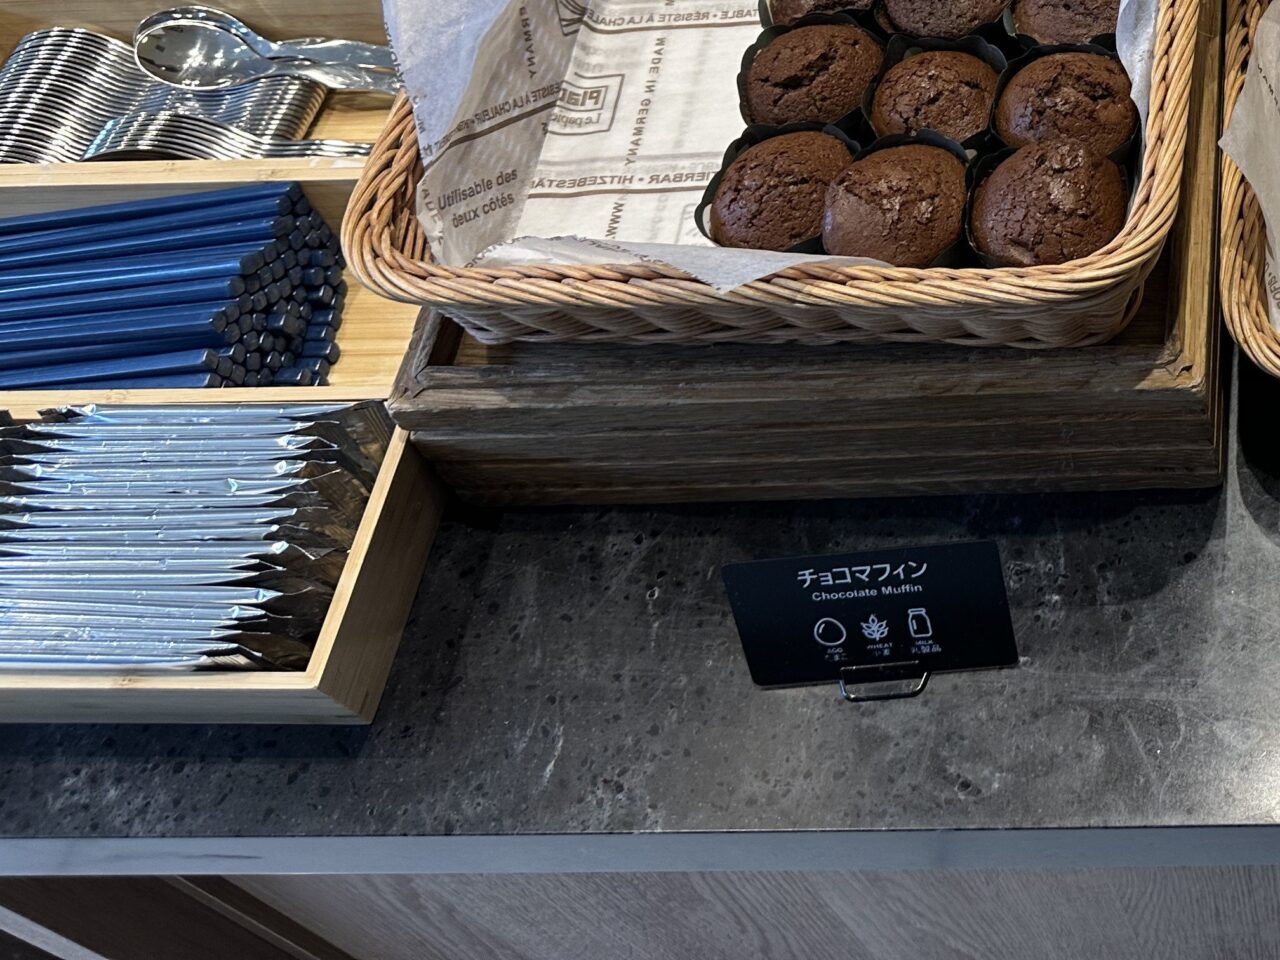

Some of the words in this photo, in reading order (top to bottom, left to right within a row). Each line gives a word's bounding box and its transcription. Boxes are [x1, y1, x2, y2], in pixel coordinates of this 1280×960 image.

[438, 178, 494, 212] Utilisable
[496, 168, 518, 187] des
[452, 205, 480, 229] deux
[482, 191, 515, 215] côtés
[797, 560, 928, 589] チョコマフィン
[811, 588, 878, 601] Chocolate
[881, 584, 923, 596] Muffin
